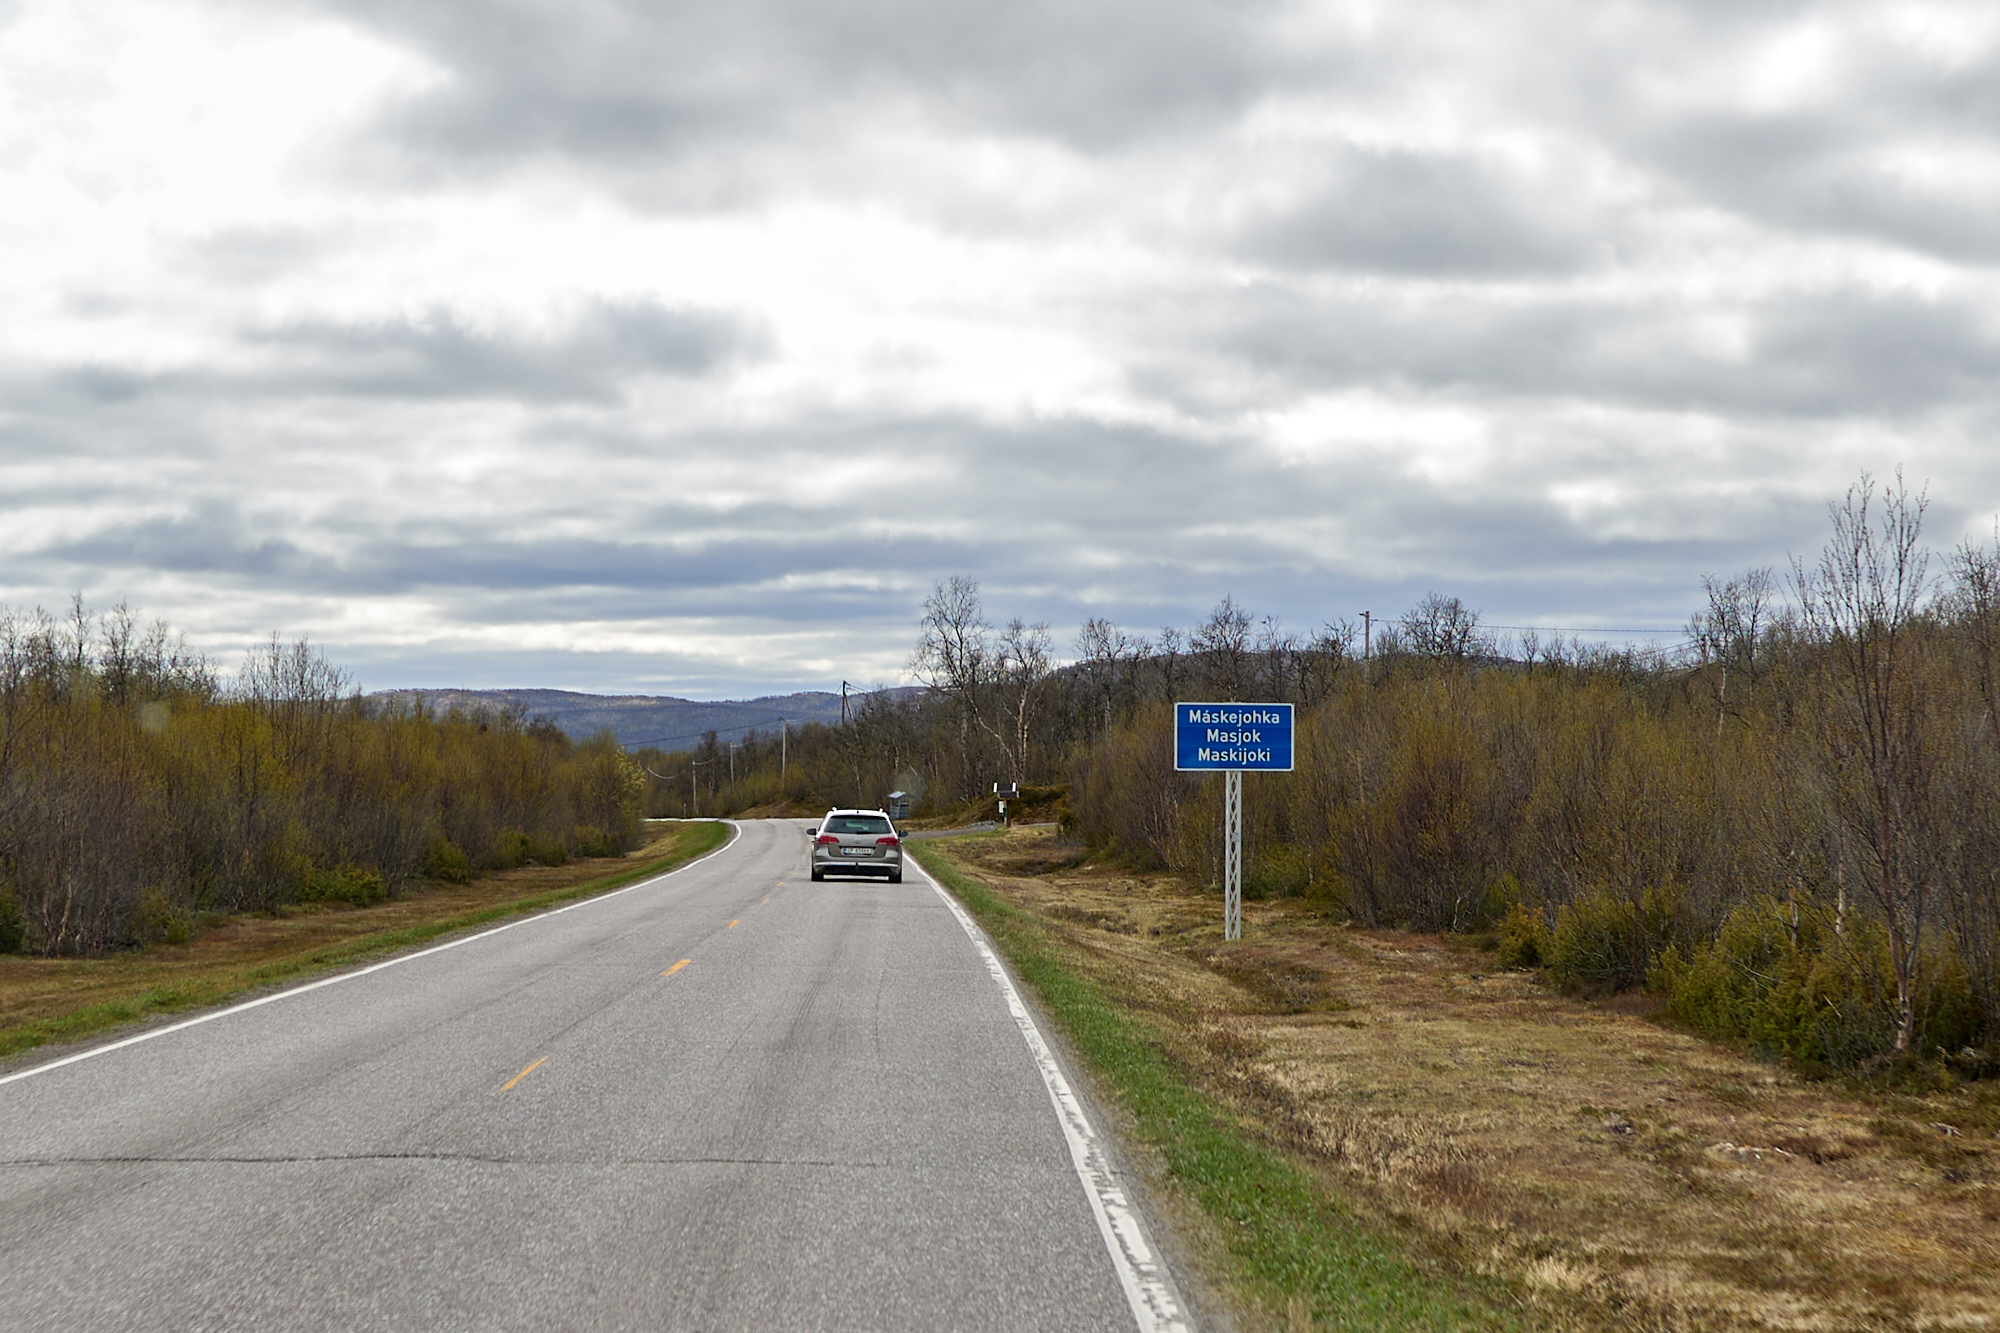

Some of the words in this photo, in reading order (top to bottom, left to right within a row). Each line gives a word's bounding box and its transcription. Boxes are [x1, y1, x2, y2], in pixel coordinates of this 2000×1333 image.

[1189, 709, 1280, 727] Máskejohka
[1207, 728, 1261, 746] Masjok
[1198, 748, 1270, 765] Maskijoki
